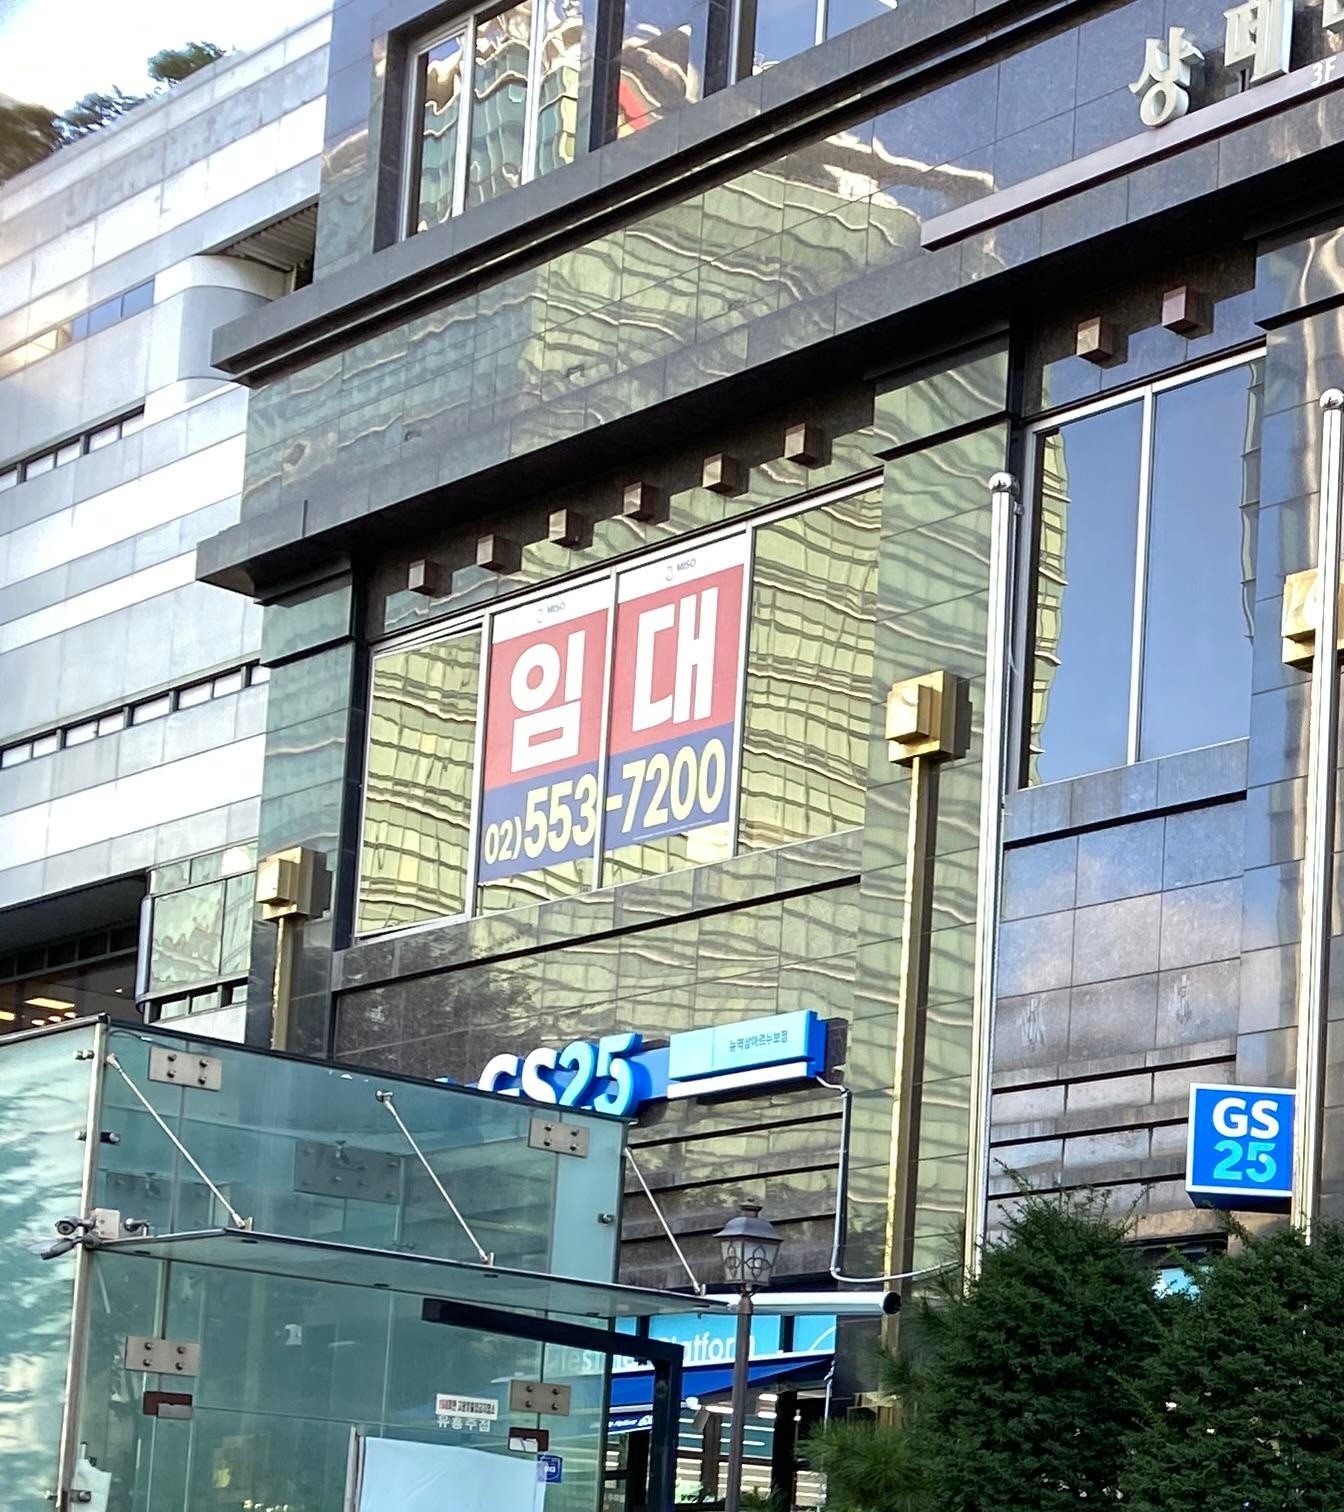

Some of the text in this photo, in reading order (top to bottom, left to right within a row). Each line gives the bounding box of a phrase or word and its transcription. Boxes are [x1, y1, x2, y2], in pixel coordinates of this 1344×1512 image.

[1310, 55, 1337, 88] 3F
[510, 587, 719, 773] 임대
[484, 737, 727, 866] 02)553-7200
[1212, 1097, 1280, 1139] GS
[1212, 1139, 1278, 1183] 25
